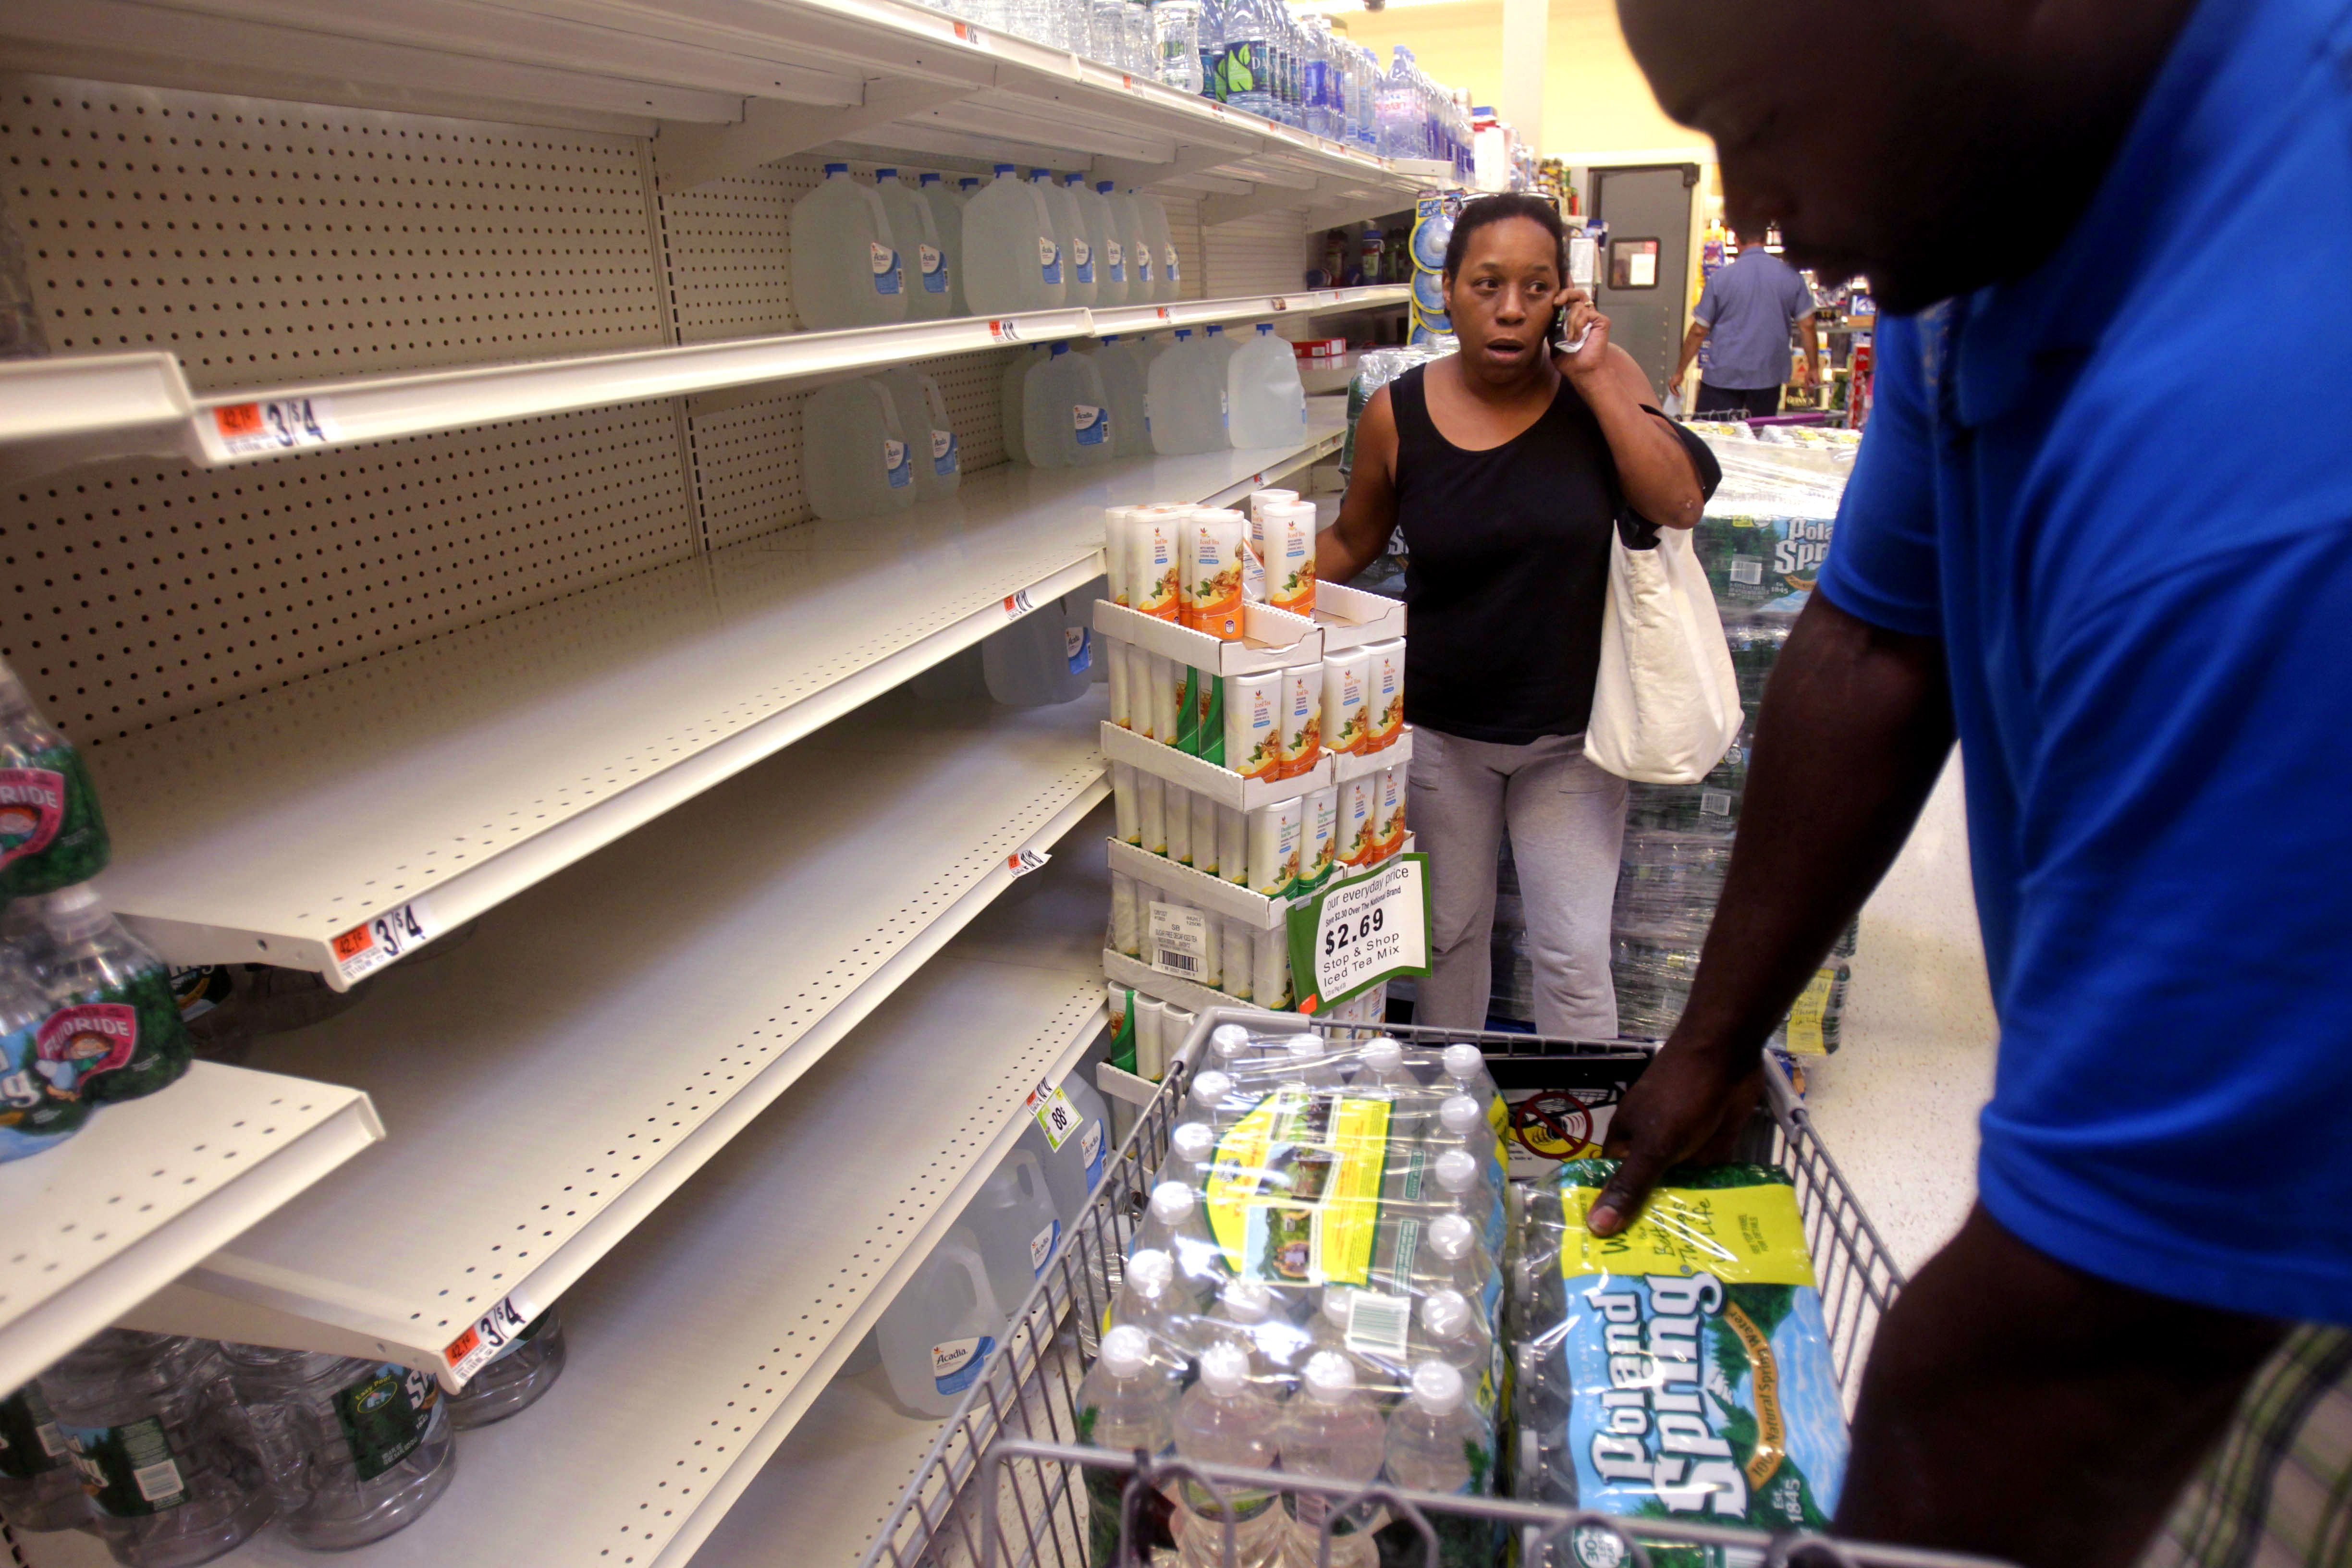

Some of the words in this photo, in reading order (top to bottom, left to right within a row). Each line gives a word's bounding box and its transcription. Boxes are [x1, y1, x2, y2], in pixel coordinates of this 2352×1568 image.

[1325, 917, 1335, 927] Save
[1335, 910, 1347, 922] $2.30
[1348, 906, 1360, 916] Over
[1361, 902, 1370, 912] The
[1370, 894, 1385, 908] National
[1386, 886, 1401, 897] Brand
[1327, 894, 1340, 911] our
[1343, 877, 1384, 903] everyday
[1385, 867, 1409, 887] price
[375, 904, 426, 956] 3/$4
[1325, 908, 1384, 957] $2.69
[1323, 955, 1349, 973] Stop
[1354, 947, 1361, 957] &
[1366, 932, 1399, 951] Shop
[1324, 968, 1348, 987] Iced
[1352, 956, 1373, 972] Tea
[1377, 945, 1400, 961] Mix
[1692, 1197, 1717, 1235] Life
[1034, 1236, 1049, 1257] Acadia
[480, 1297, 527, 1347] 3/$4
[1731, 1311, 1760, 1349] Water
[937, 1348, 968, 1365] Acadia
[1757, 1348, 1776, 1391] Spring
[355, 1386, 373, 1400] Easy
[373, 1375, 392, 1387] Pour
[1587, 1293, 1654, 1481] Poland
[1645, 1272, 1746, 1519] Spring
[1758, 1393, 1779, 1443] Natural
[1772, 1488, 1784, 1510] Est.
[1785, 1478, 1803, 1523] 1845
